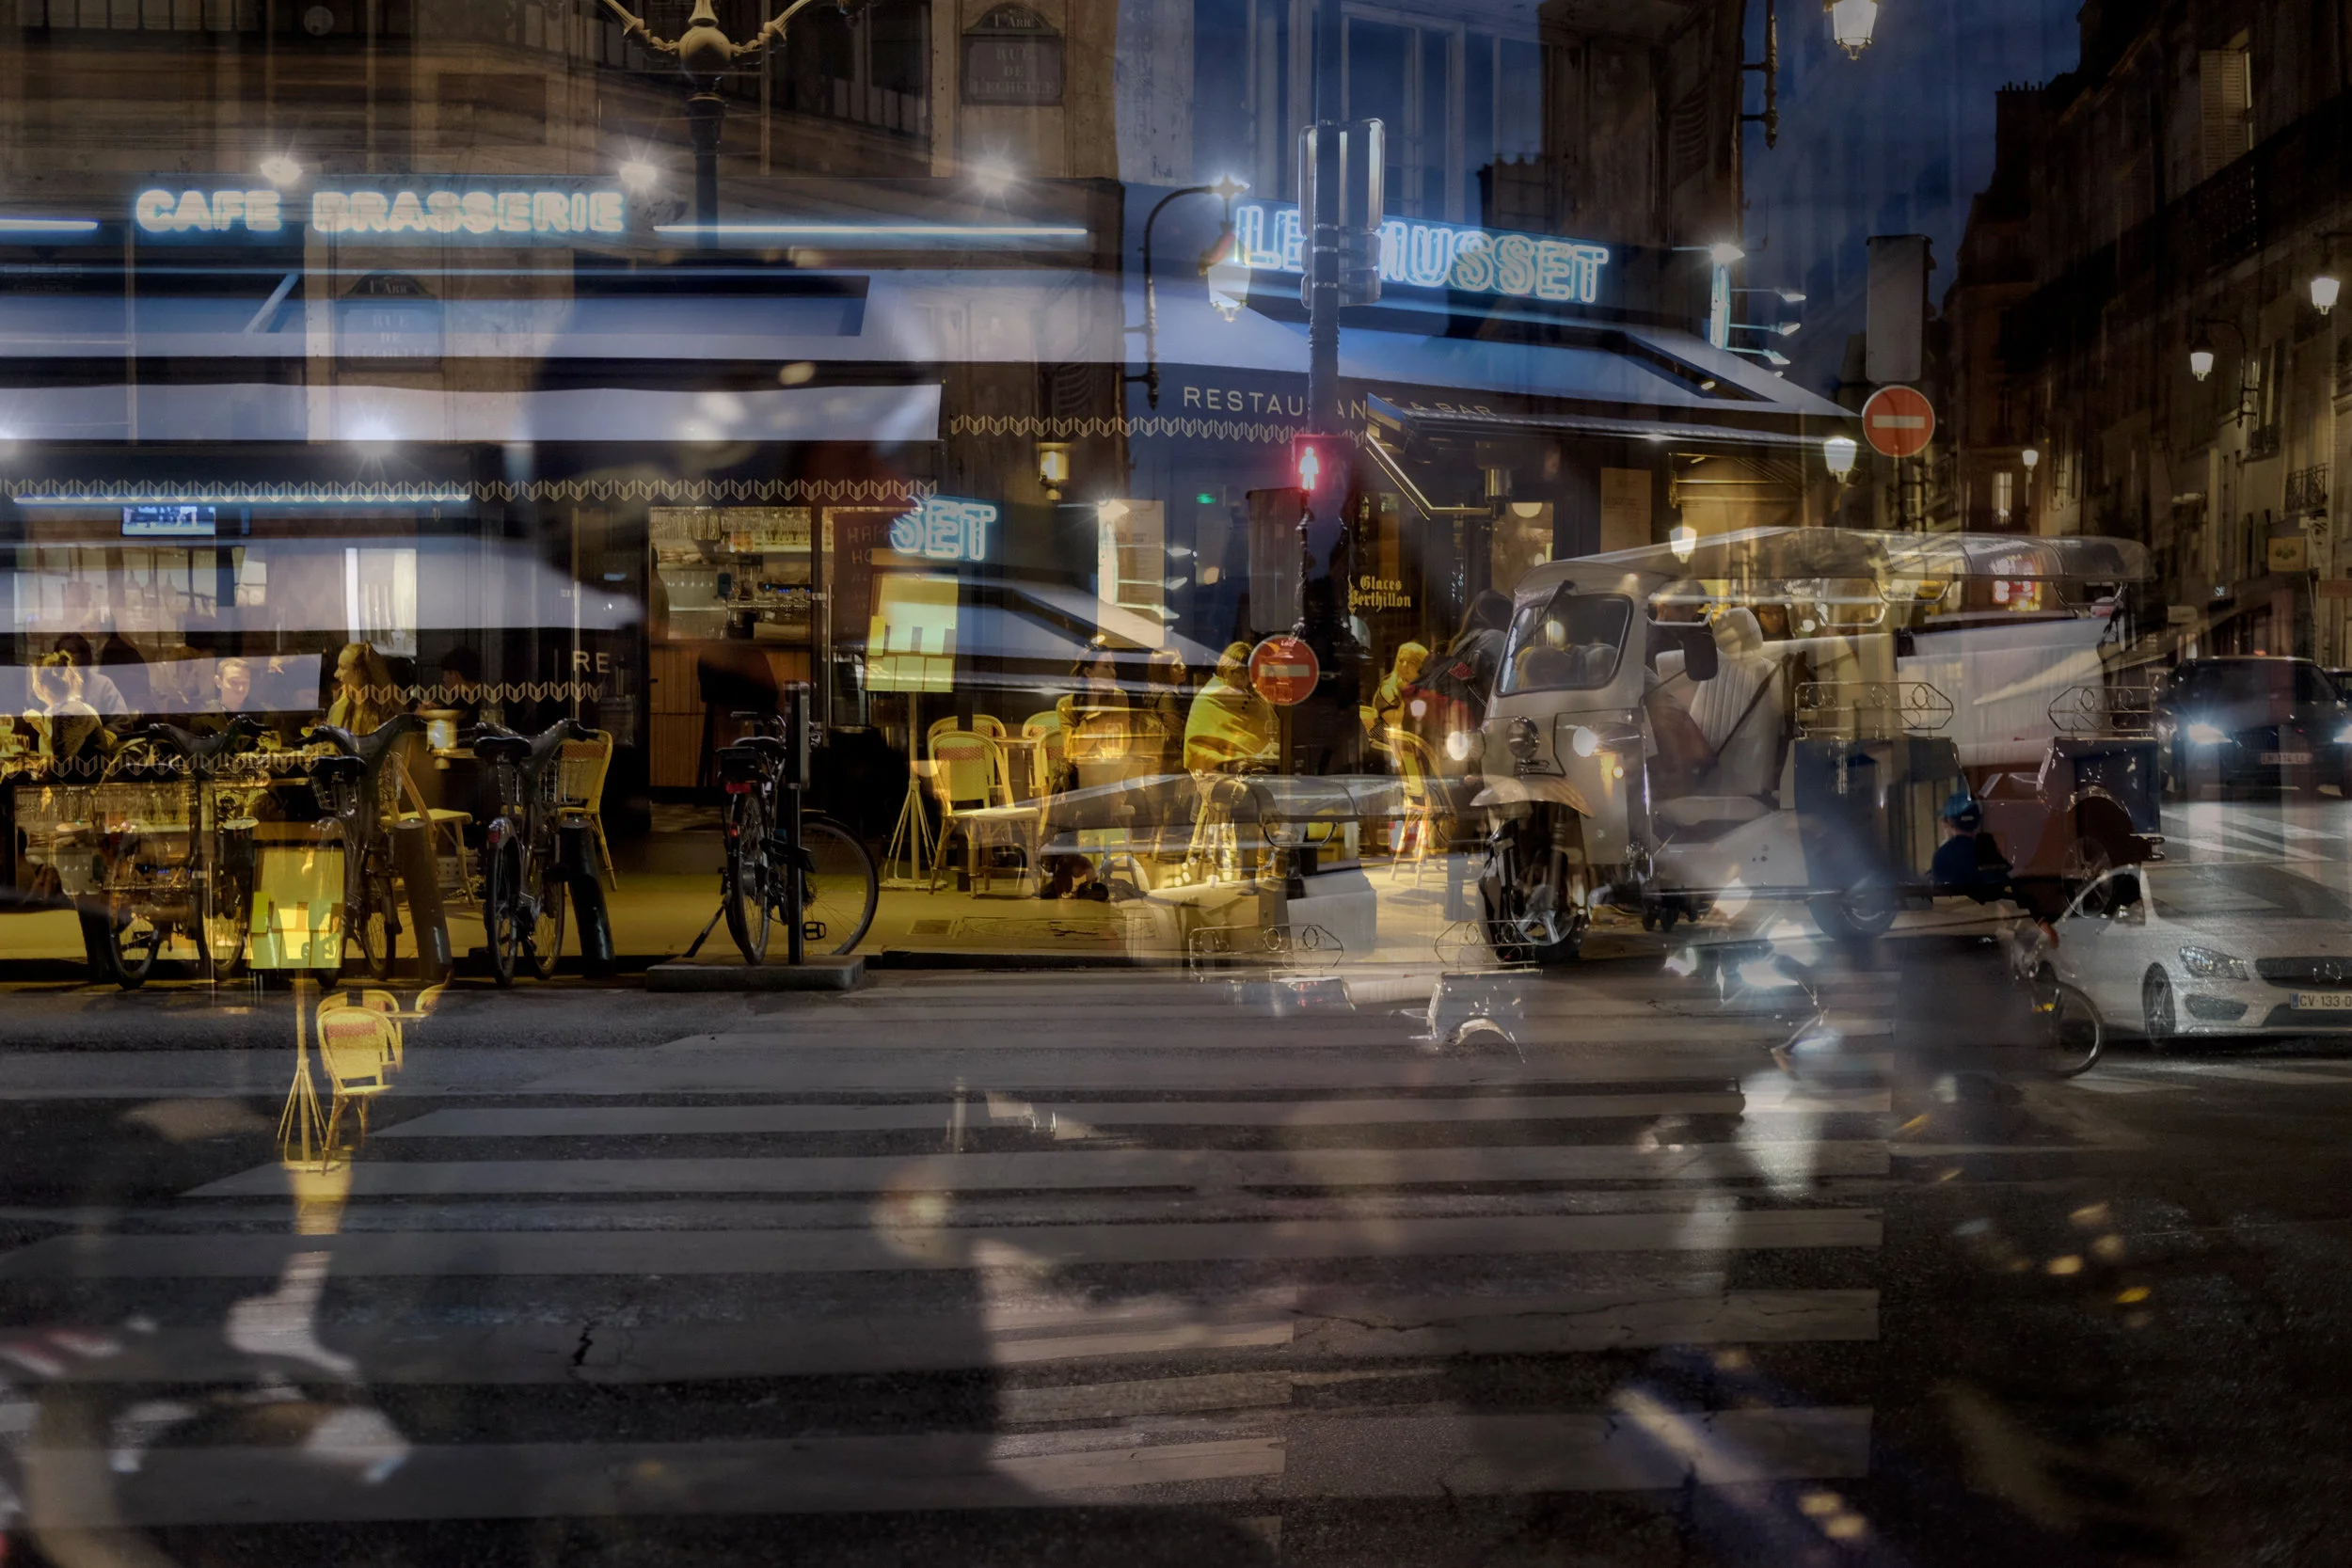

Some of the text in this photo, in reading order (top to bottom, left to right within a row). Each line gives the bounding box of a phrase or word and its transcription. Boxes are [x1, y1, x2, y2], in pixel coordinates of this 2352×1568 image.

[995, 47, 1034, 61] RUE
[1004, 64, 1026, 77] DE
[312, 191, 623, 233] BRASSERIE
[1359, 575, 1403, 593] Glaces
[1348, 589, 1412, 613] Berthillon
